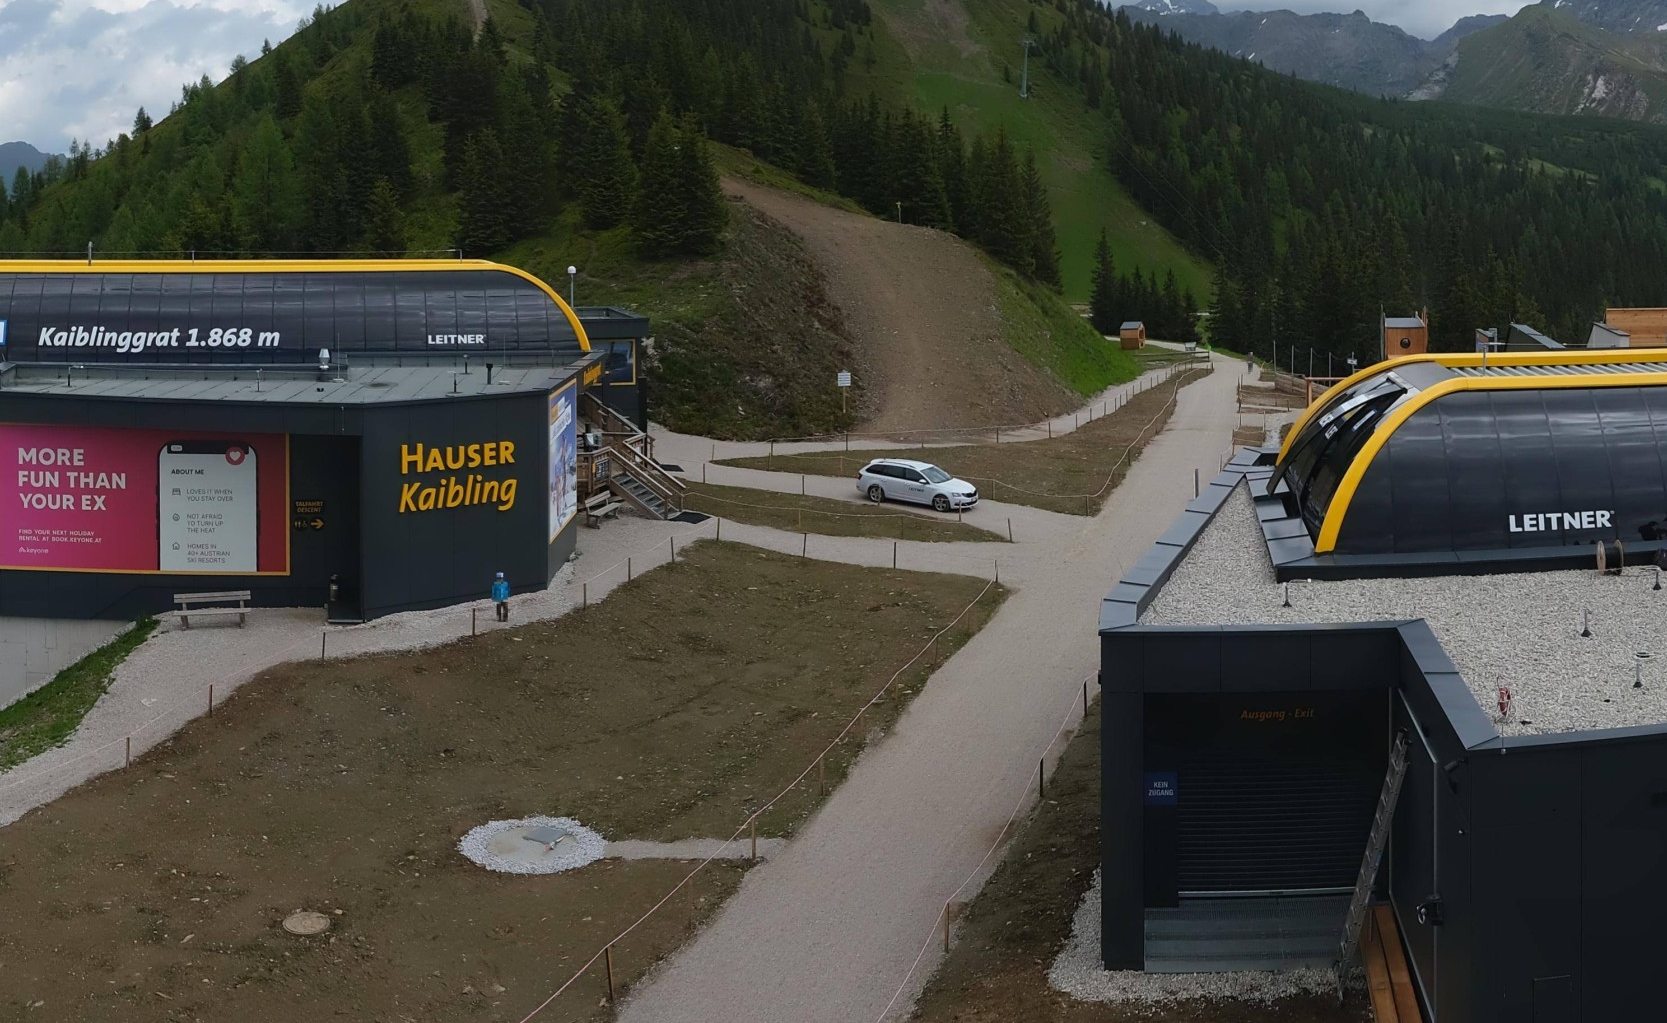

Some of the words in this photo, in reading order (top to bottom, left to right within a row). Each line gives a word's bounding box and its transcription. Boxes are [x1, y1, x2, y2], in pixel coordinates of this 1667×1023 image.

[38, 326, 180, 353] Kaiblinggrat
[185, 327, 251, 347] 1.868
[258, 332, 280, 347] m
[427, 334, 485, 345] LEITNER
[18, 447, 84, 466] MORE
[400, 440, 516, 475] HAUSER
[18, 470, 59, 488] FUN
[66, 471, 126, 490] THAN
[19, 493, 75, 510] YOUR
[81, 495, 107, 511] EX
[399, 474, 518, 513] Kaibling
[1508, 510, 1613, 533] LEITNER
[26, 547, 49, 555] keyone
[1240, 709, 1286, 722] Ausgang
[1294, 707, 1315, 718] Exit
